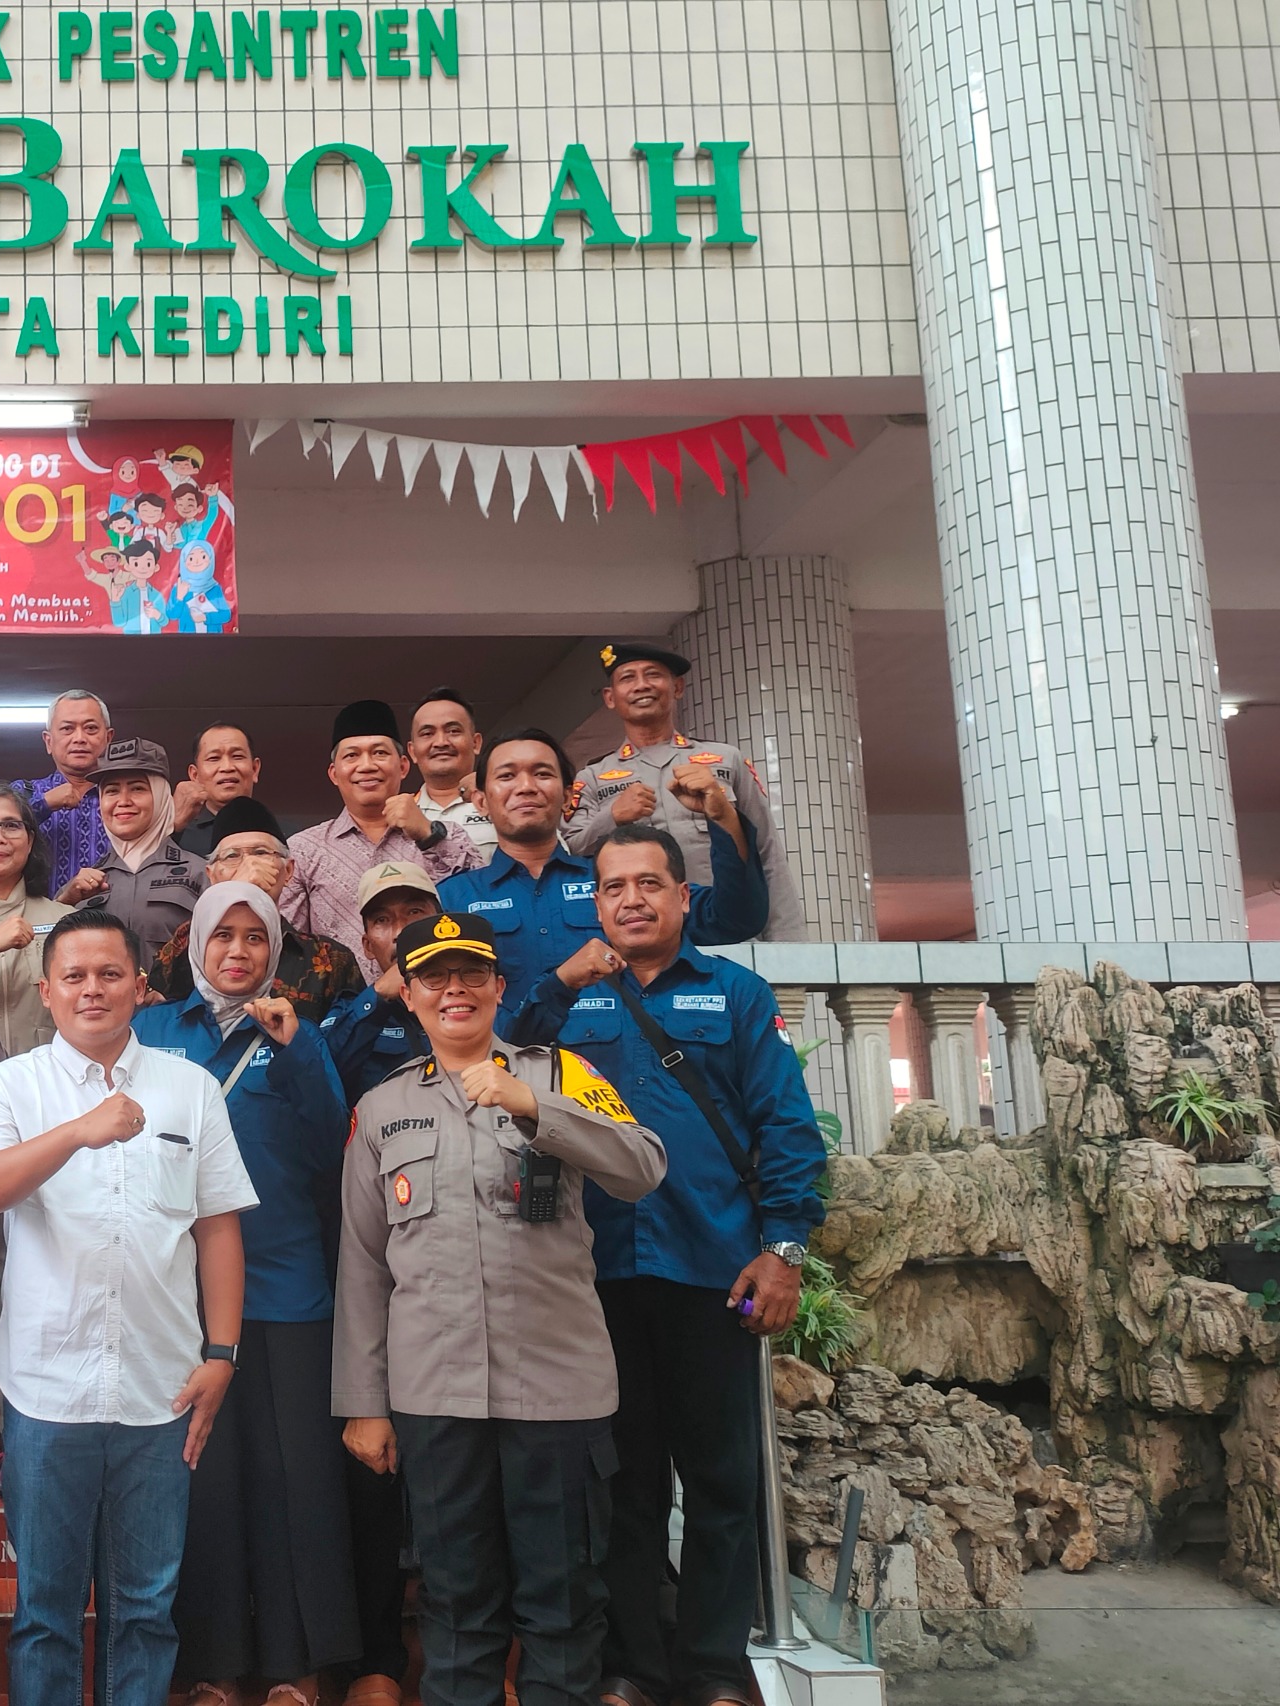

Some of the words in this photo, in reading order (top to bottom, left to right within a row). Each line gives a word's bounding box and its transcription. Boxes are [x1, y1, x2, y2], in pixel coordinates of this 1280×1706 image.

[59, 8, 459, 83] PESANTREN
[96, 295, 352, 358] KEDIRI
[30, 453, 62, 478] DI
[10, 593, 91, 607] Membuat
[380, 1117, 435, 1140] KRISTIN
